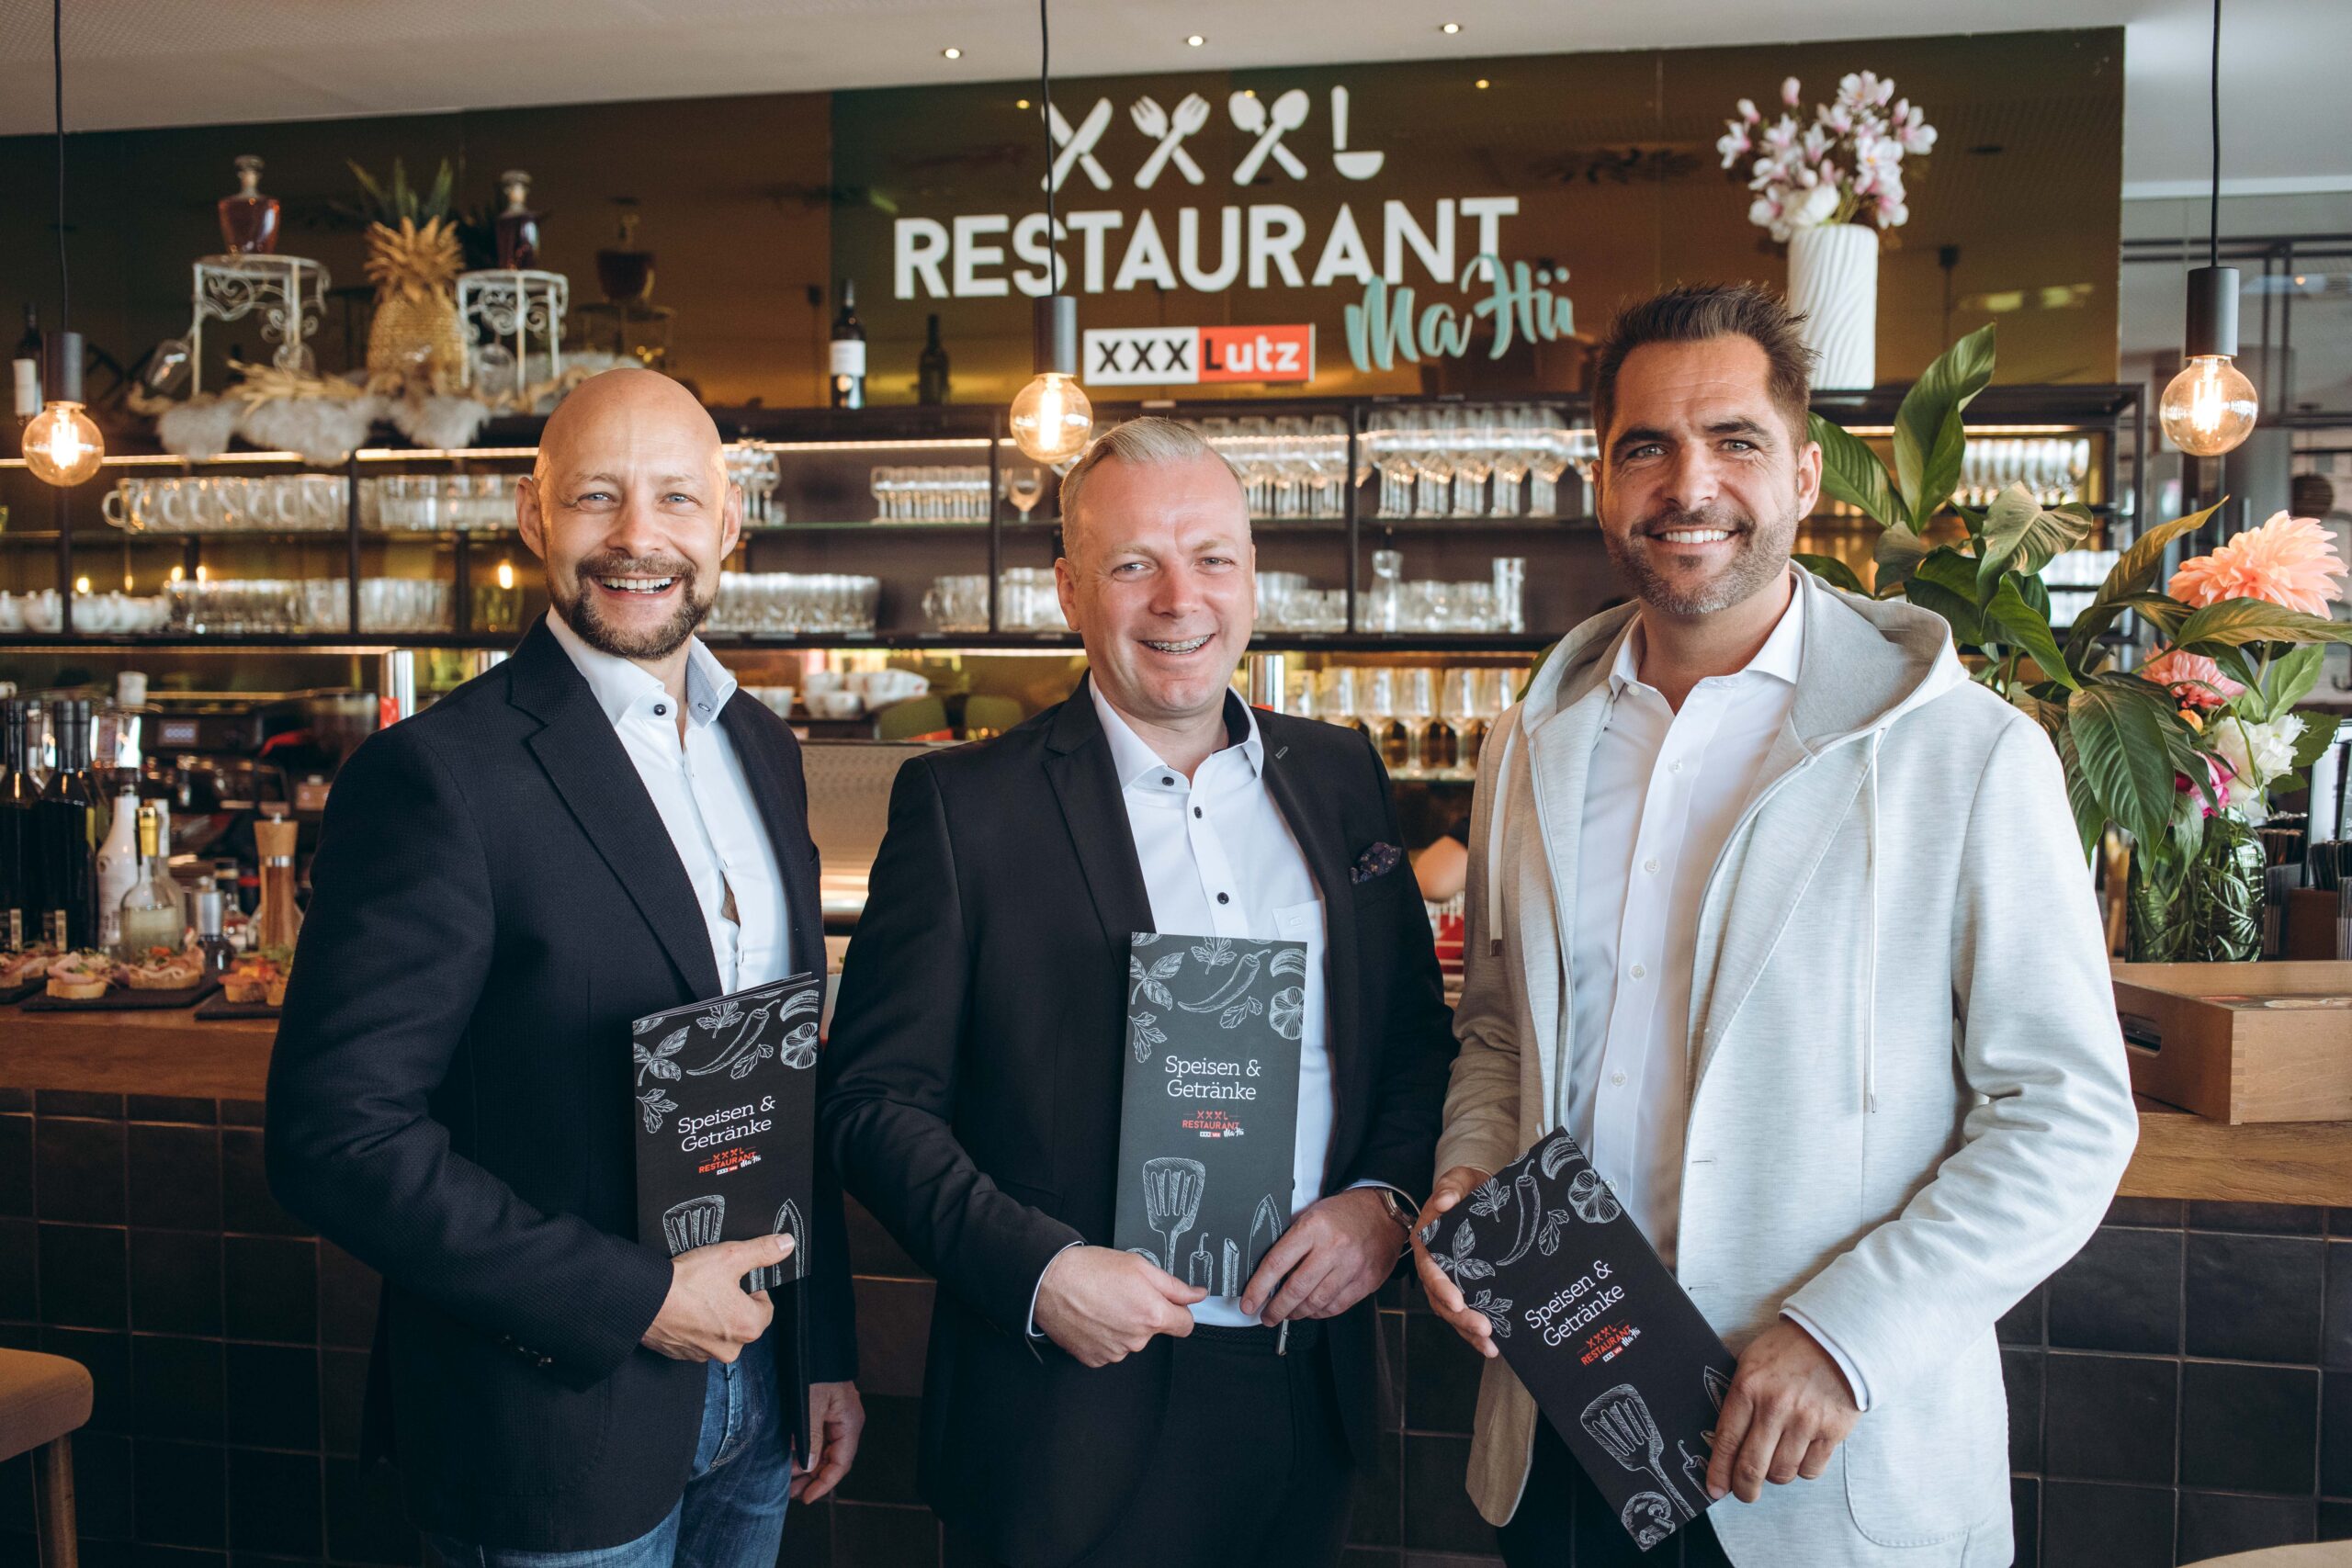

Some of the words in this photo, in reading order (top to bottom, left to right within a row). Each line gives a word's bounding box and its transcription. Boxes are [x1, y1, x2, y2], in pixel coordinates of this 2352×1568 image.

[893, 197, 1520, 299] RESTAURANT
[1165, 1055, 1240, 1077] Speisen
[1246, 1059, 1261, 1077] &
[1167, 1079, 1257, 1100] Getränke
[677, 1103, 755, 1135] Speisen
[760, 1096, 775, 1111] &
[1182, 1120, 1240, 1130] RESTAURANT
[681, 1118, 773, 1152] Getränke
[698, 1151, 757, 1174] RESTAURANT
[1524, 1275, 1596, 1329] Speisen
[1593, 1259, 1613, 1280] &
[1543, 1285, 1625, 1347] Getränke
[1580, 1325, 1631, 1366] RESTAURANT
